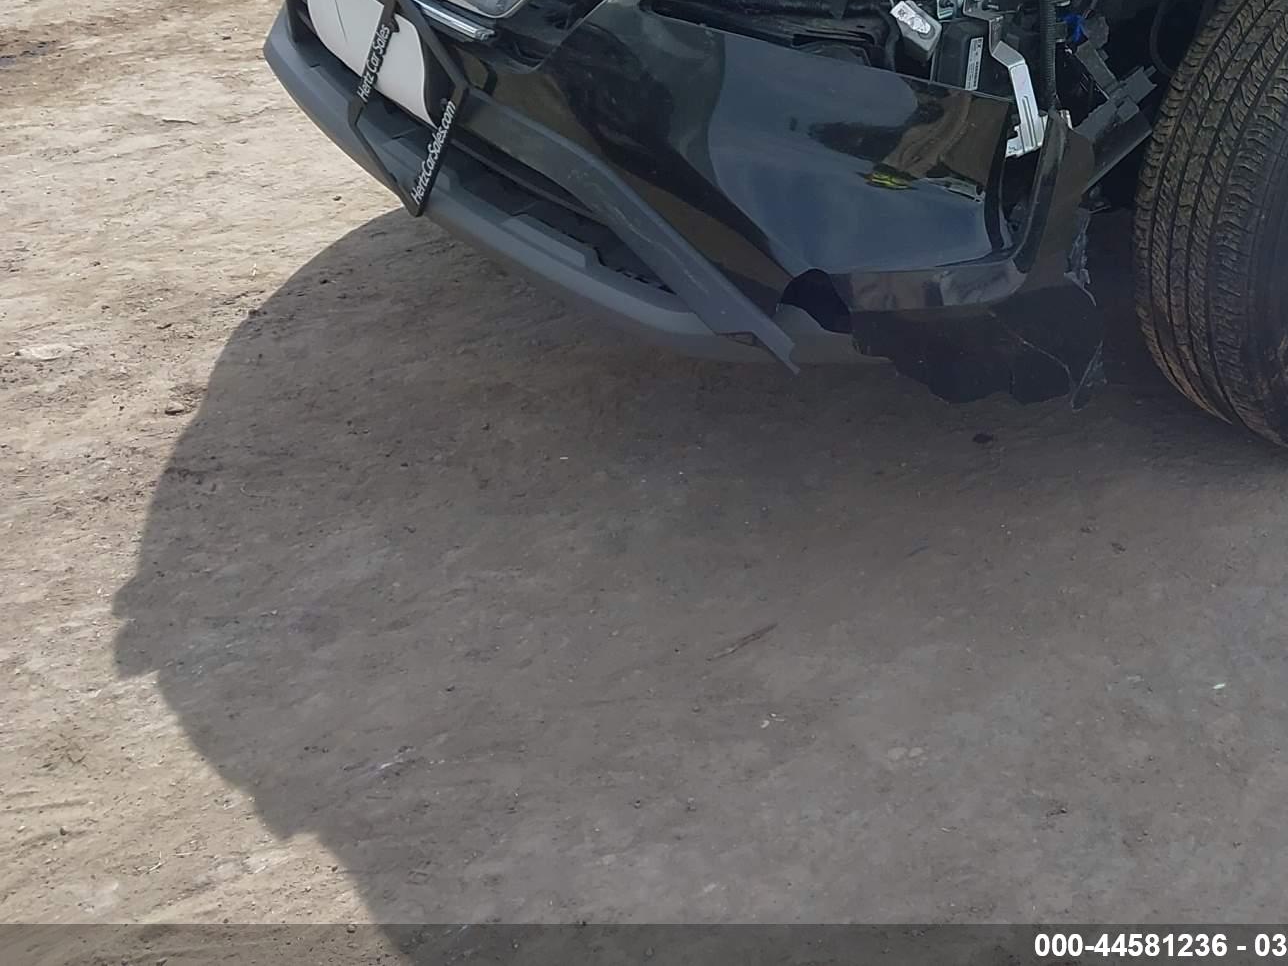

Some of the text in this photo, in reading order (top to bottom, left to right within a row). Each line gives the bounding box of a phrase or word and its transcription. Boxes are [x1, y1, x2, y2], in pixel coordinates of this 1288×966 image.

[356, 24, 391, 104] Hertz Car Sales
[409, 100, 456, 205] HertzCarSales.com
